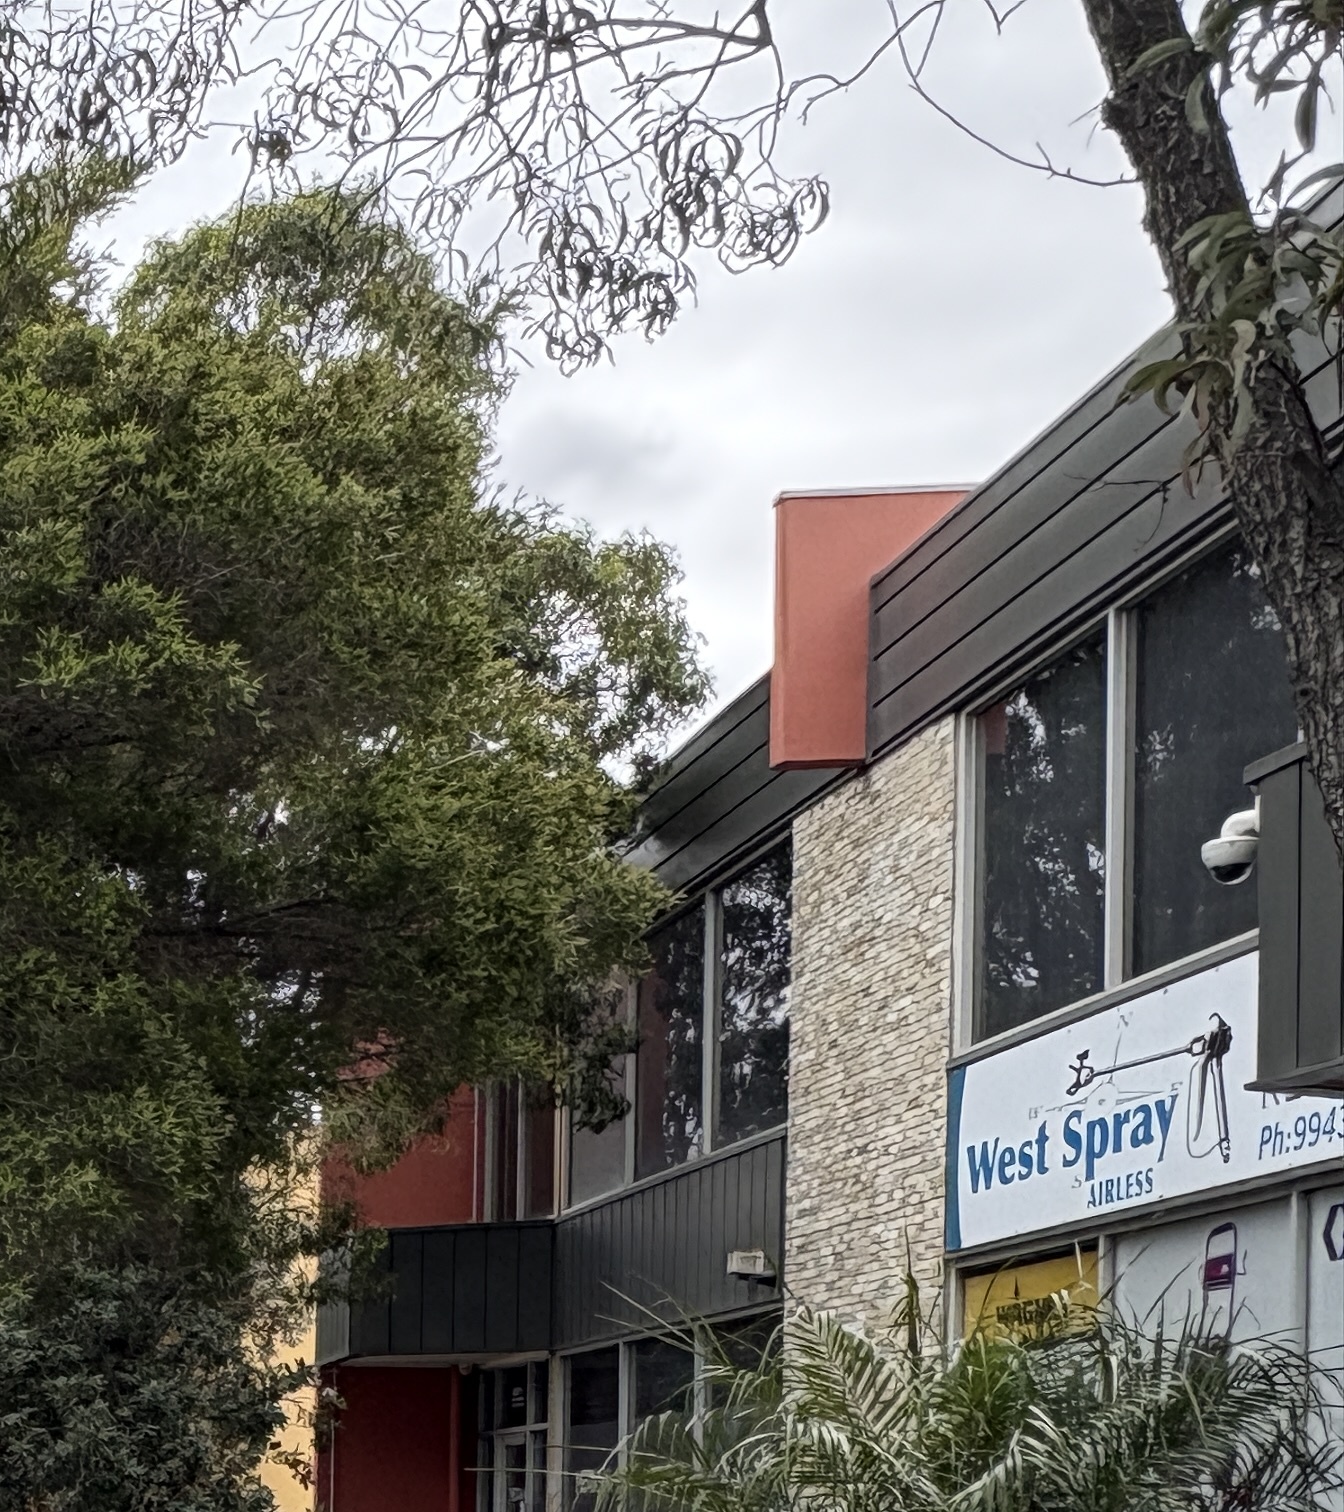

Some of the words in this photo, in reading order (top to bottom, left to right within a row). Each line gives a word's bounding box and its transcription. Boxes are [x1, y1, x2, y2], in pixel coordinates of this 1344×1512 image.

[966, 1120, 1049, 1194] West
[1062, 1093, 1180, 1182] Spray
[1087, 1168, 1154, 1208] AIRLESS
